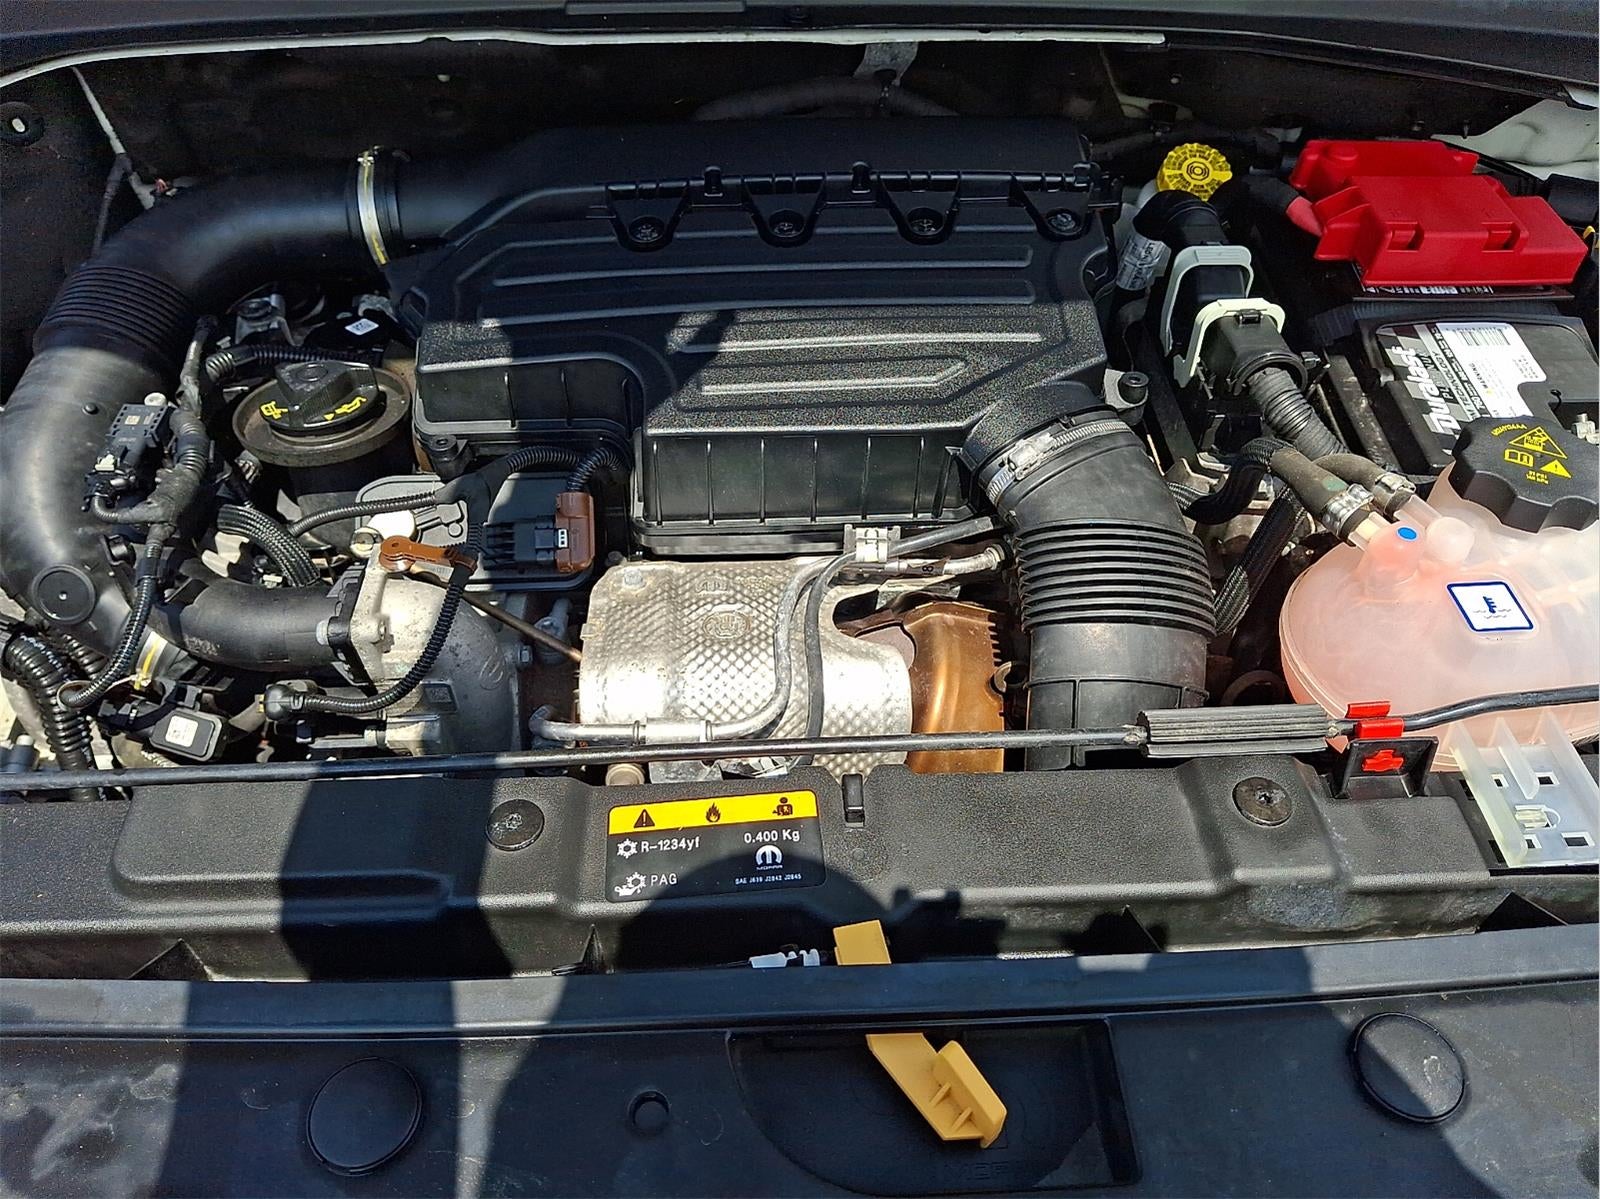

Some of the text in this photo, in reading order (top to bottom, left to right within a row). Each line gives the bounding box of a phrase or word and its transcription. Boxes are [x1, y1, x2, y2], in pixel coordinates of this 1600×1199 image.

[1431, 350, 1470, 406] TECHNOLOGY
[1391, 345, 1462, 433] Duralast
[641, 836, 700, 853] R-1234yf
[744, 829, 800, 844] 0.400 Kg
[650, 873, 678, 886] PAG
